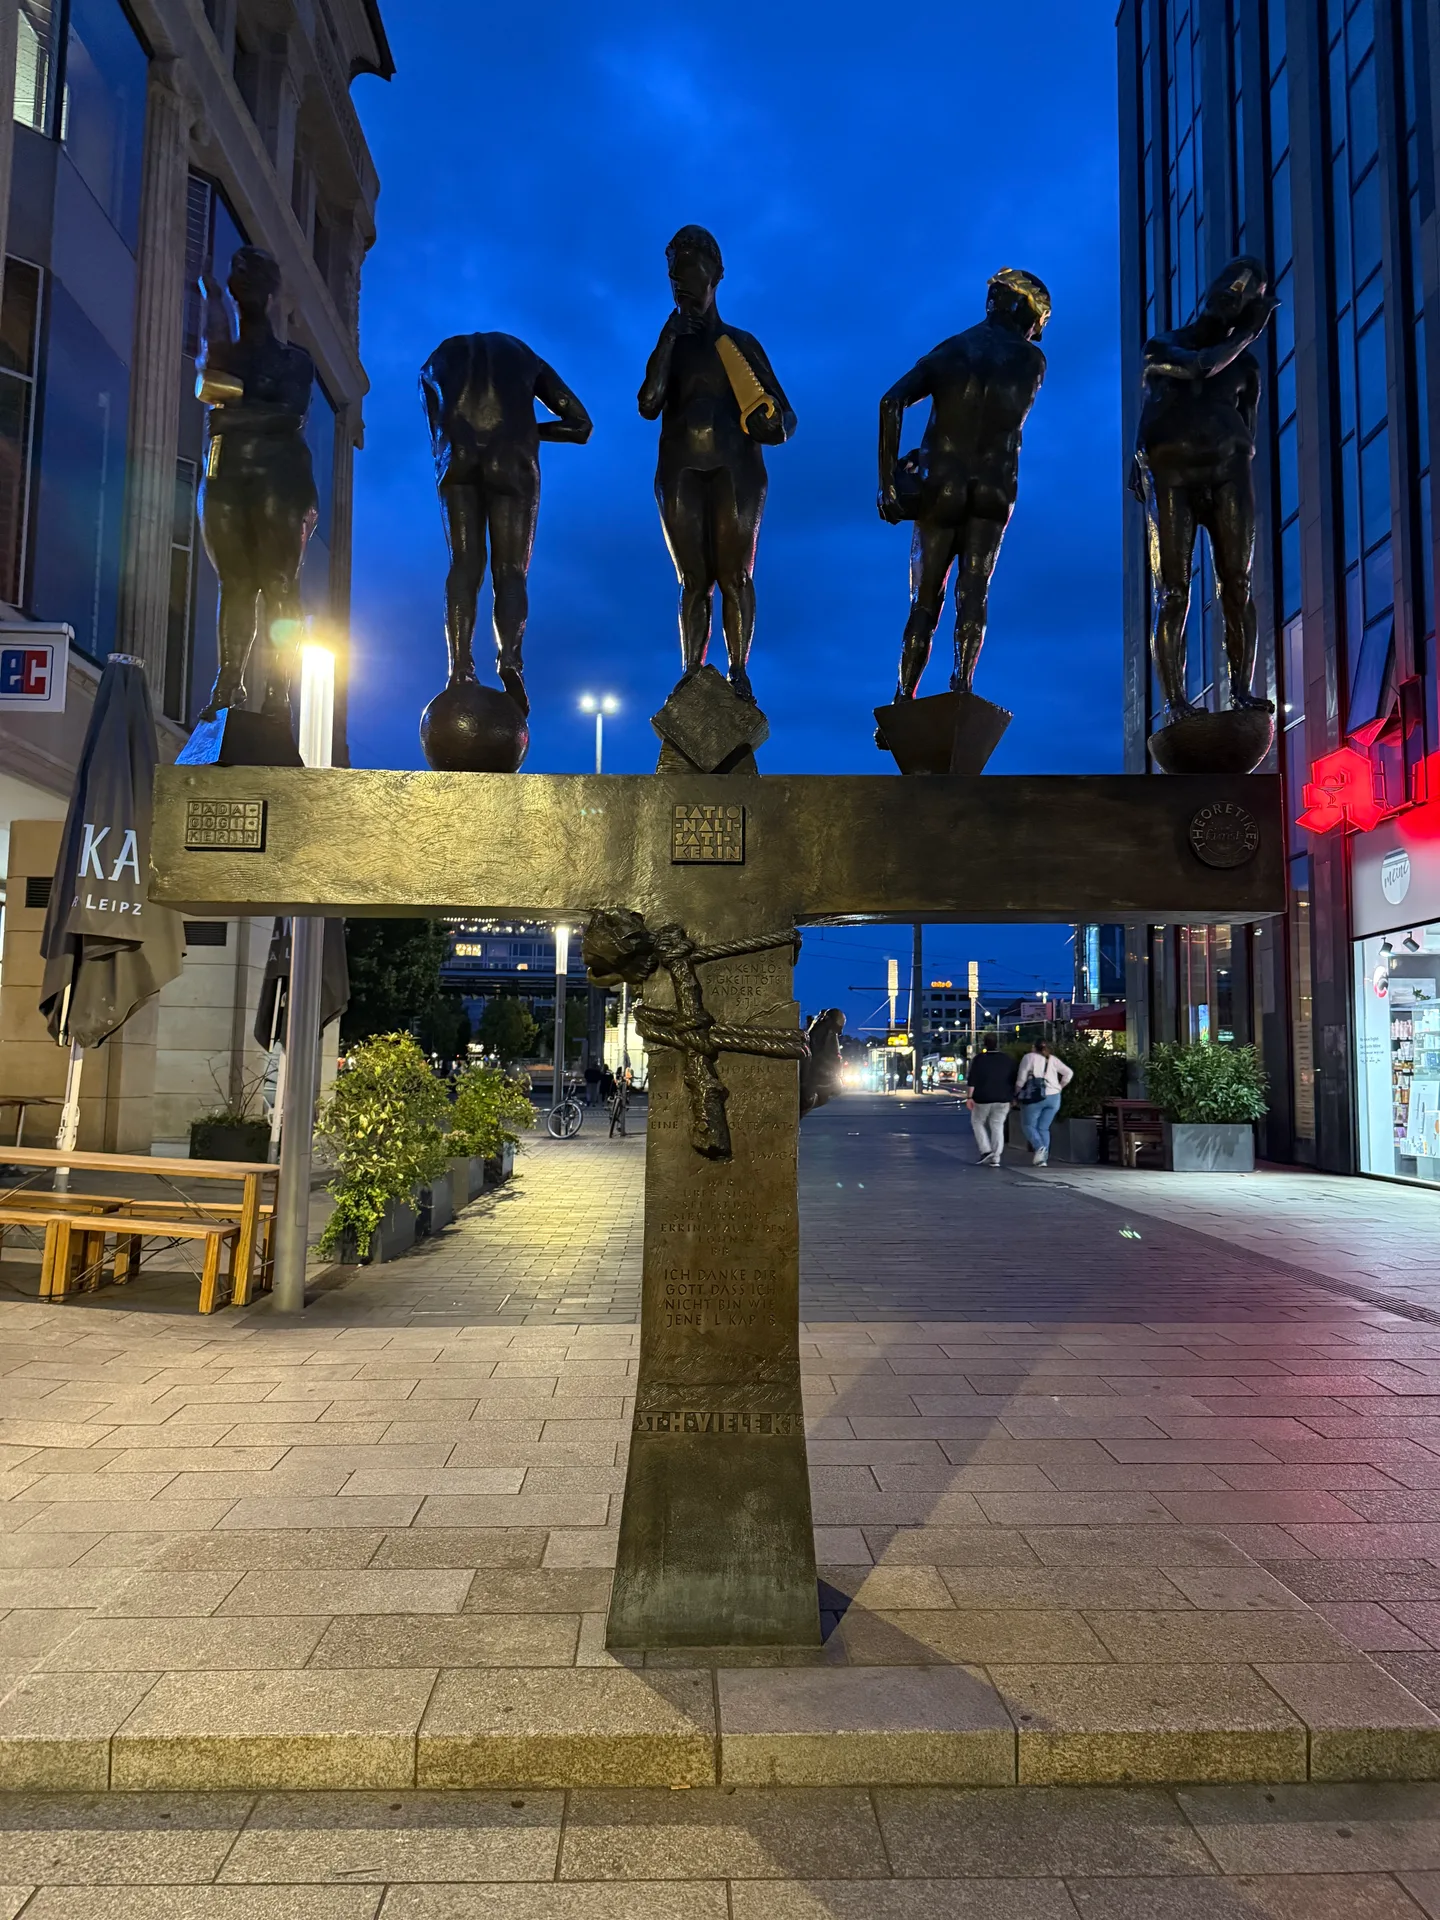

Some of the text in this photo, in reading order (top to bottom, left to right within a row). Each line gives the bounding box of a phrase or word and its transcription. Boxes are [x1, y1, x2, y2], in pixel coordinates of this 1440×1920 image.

[675, 805, 740, 818] RATIO
[1191, 803, 1257, 851] THEORETIKER
[189, 831, 256, 842] KERIN
[675, 846, 740, 858] KERIN
[706, 974, 750, 985] SIGKEIT
[710, 986, 762, 996] ANDERE
[650, 1121, 678, 1130] EINE
[664, 1268, 777, 1281] ICH DANKE DIR
[665, 1283, 776, 1296] GOTT DASS ICH
[664, 1298, 775, 1311] NICHT BIN WIE
[666, 1313, 702, 1328] JENE
